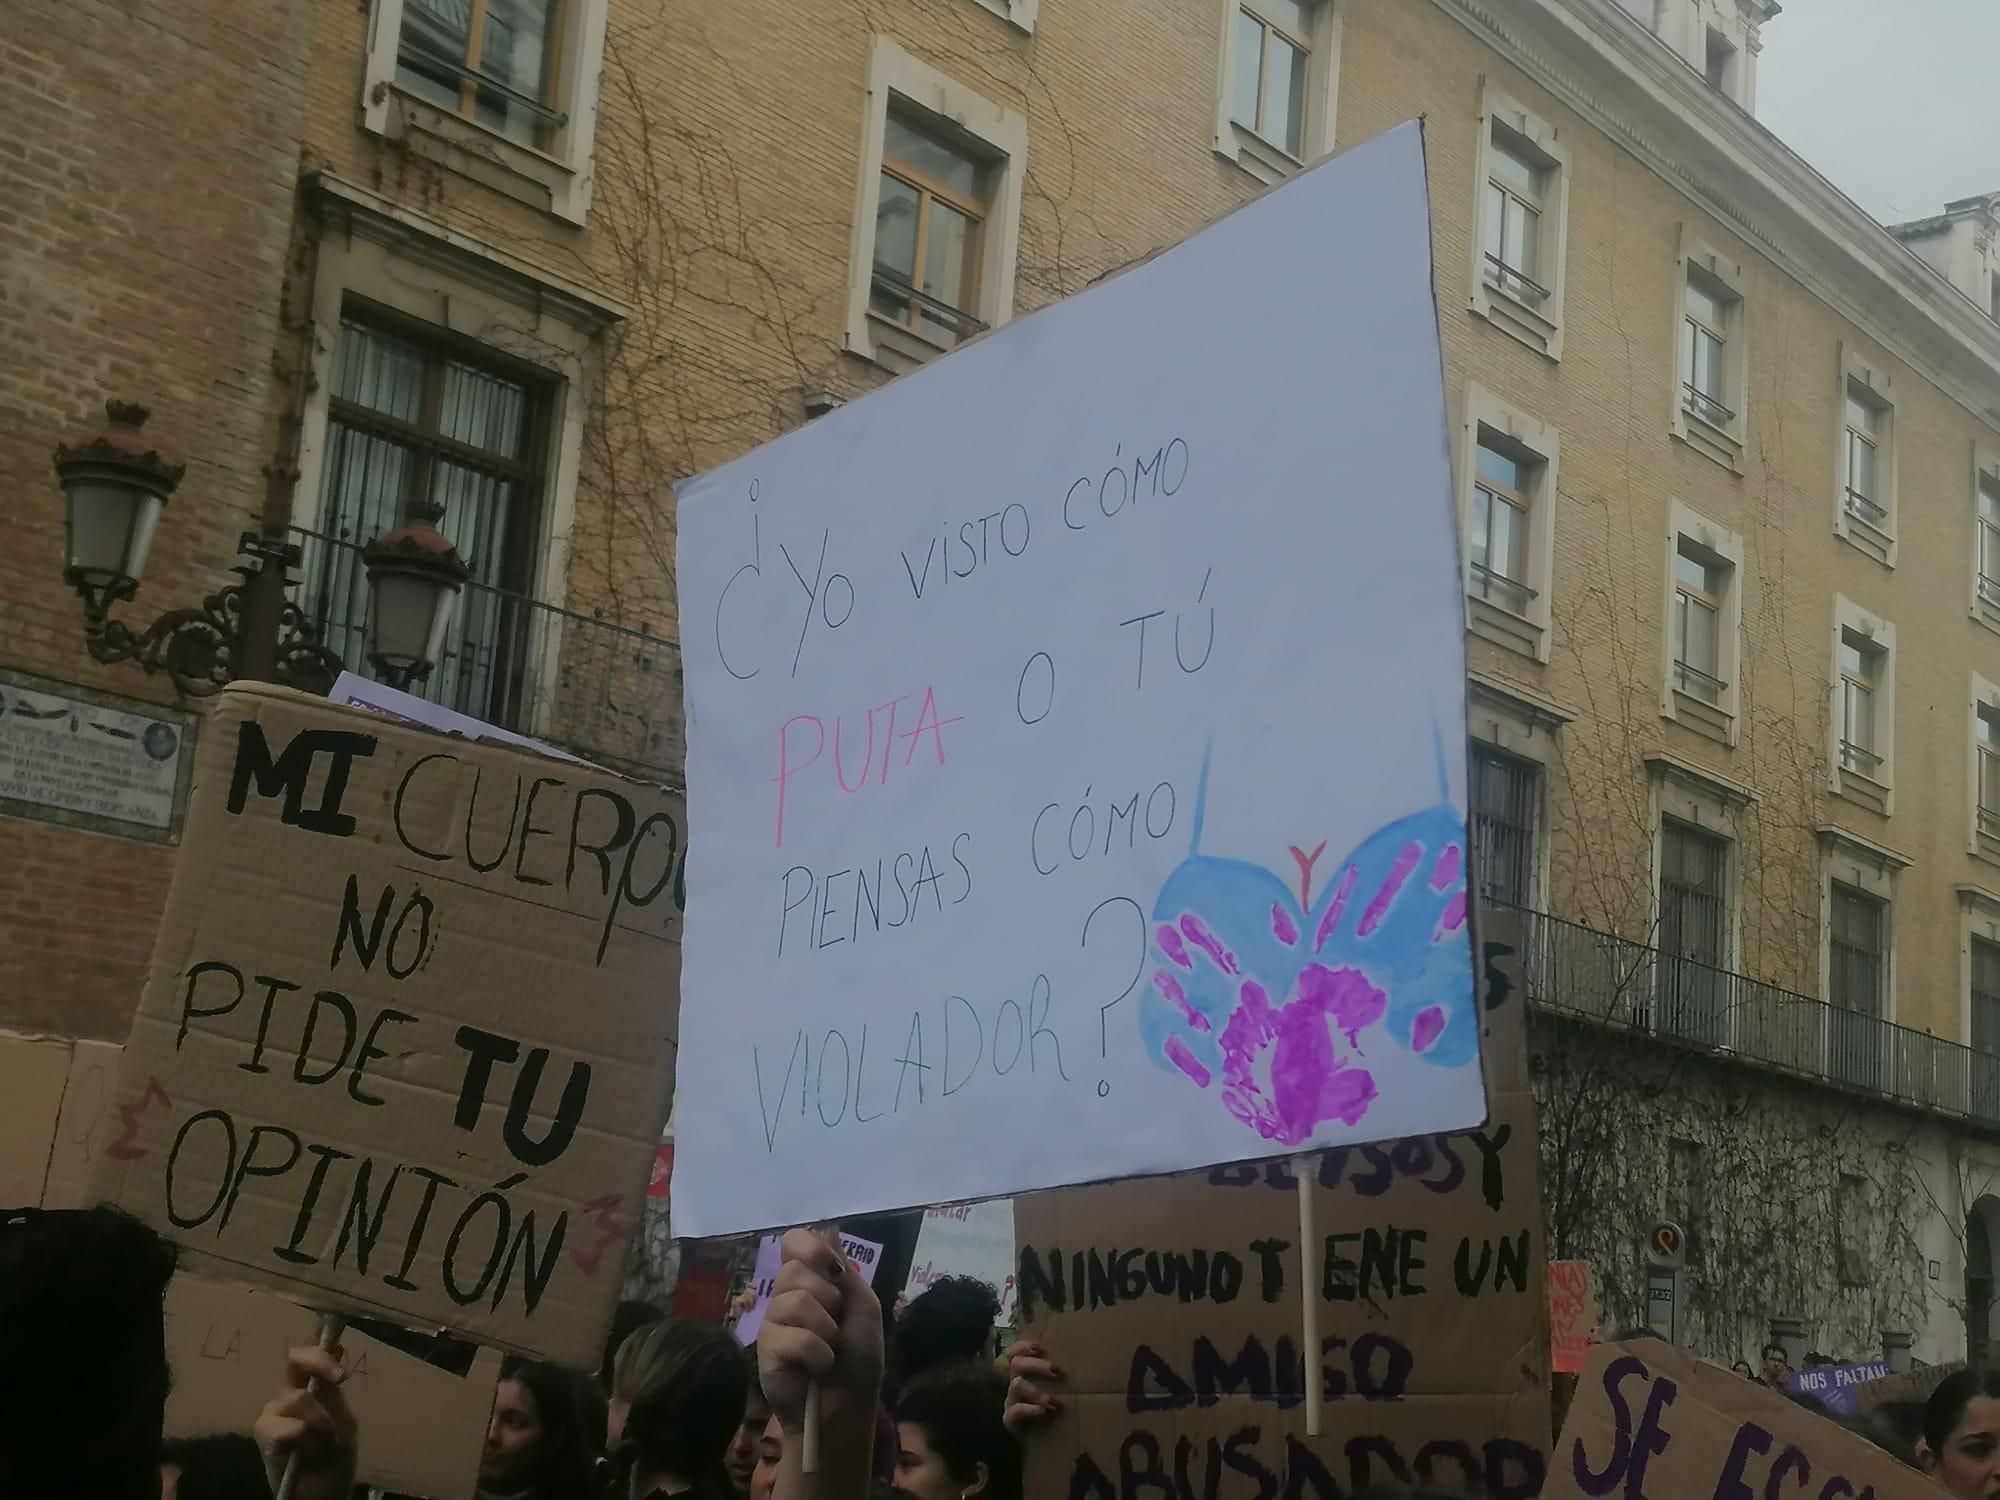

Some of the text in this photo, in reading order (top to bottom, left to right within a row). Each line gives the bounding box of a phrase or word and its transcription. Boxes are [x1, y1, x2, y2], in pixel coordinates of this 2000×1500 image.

[1063, 437, 1189, 530] CÓMO
[771, 567, 1214, 848] PUTA O TÚ
[226, 720, 378, 837] MI
[1031, 784, 1176, 875] CÓMO
[330, 873, 438, 980] NO
[176, 961, 592, 1167] PIDE TU
[165, 1109, 569, 1318] OPINIÓN
[1017, 1243, 1243, 1323] NINGUNO
[1250, 1224, 1428, 1303] TENE
[1452, 1228, 1531, 1298] UN
[1799, 1371, 1828, 1391] NOS
